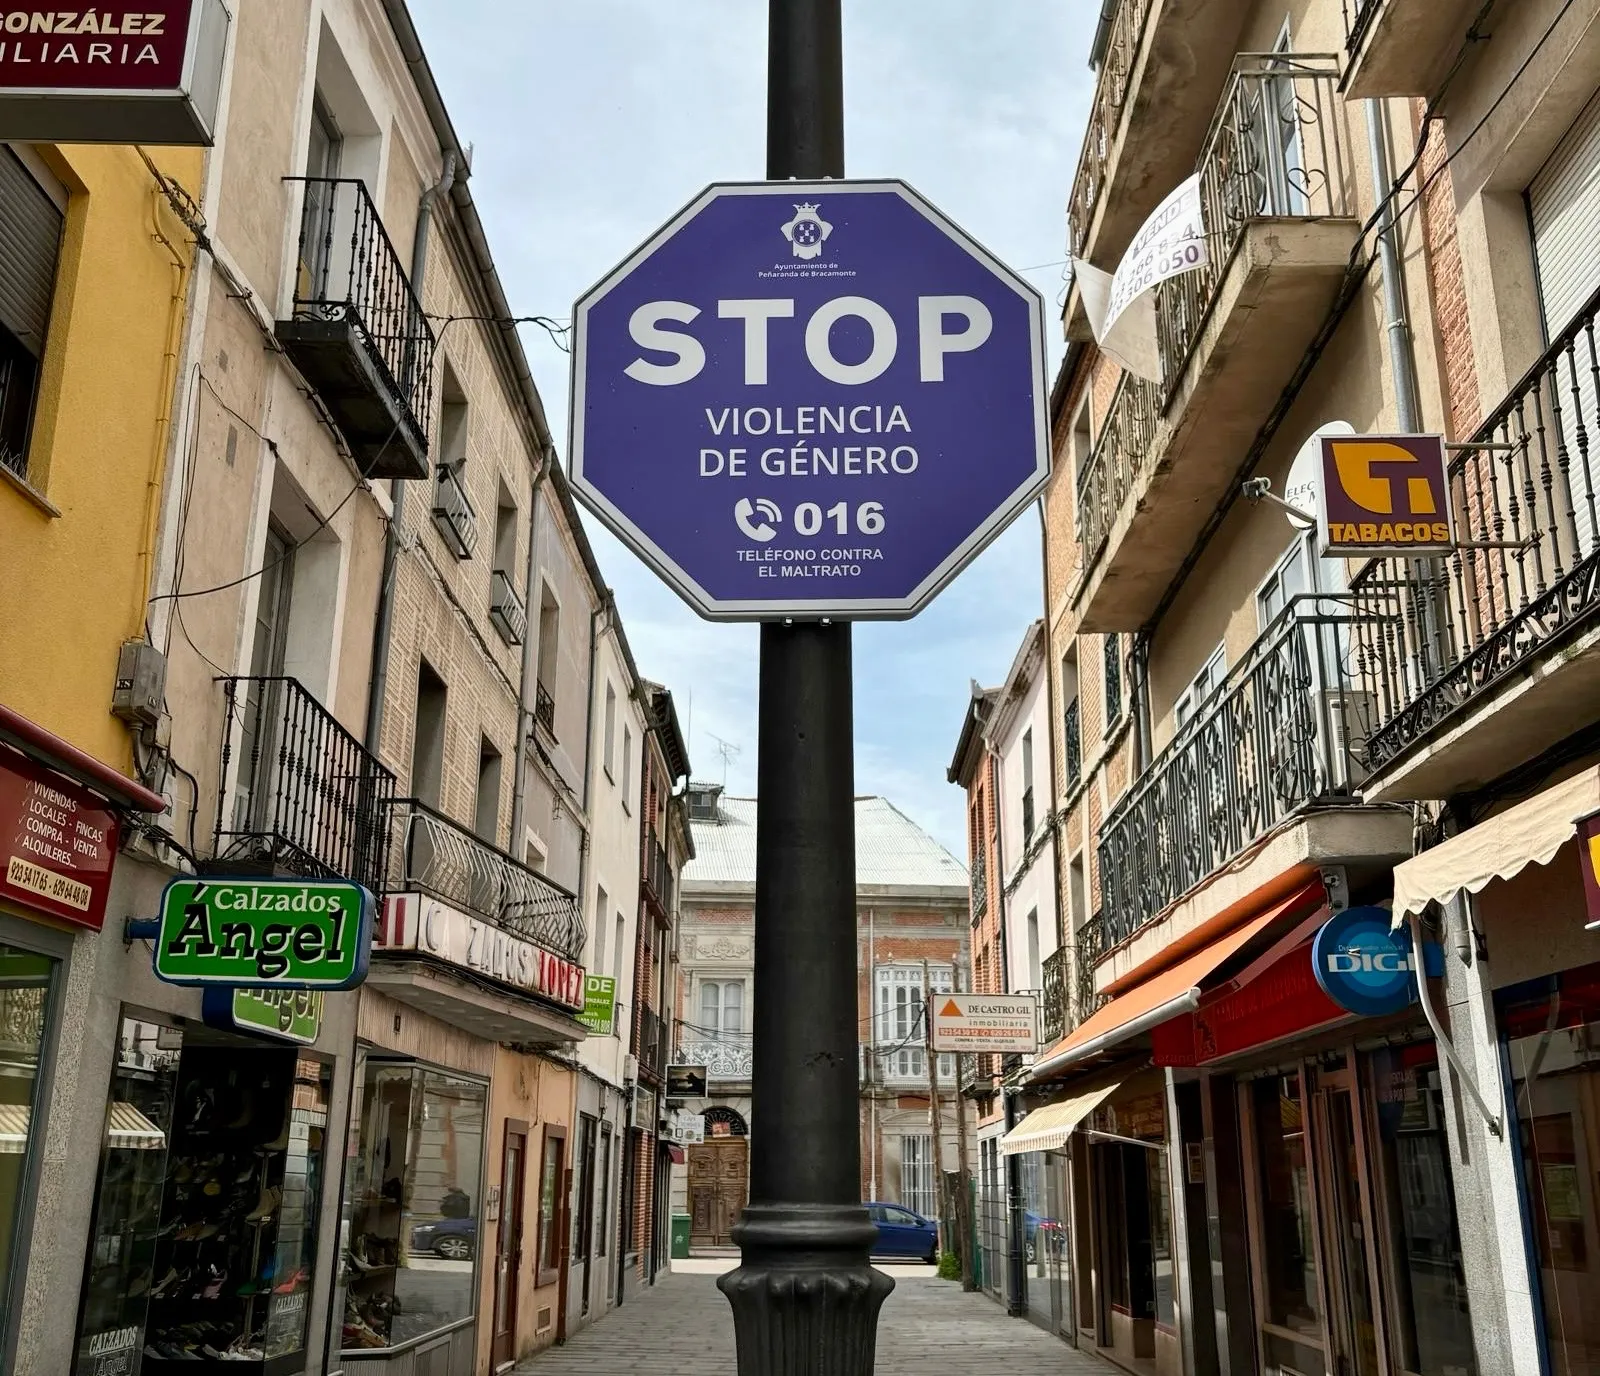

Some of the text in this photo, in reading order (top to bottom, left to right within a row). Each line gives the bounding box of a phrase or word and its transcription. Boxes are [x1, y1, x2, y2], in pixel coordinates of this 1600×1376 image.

[0, 8, 166, 35] ONZÁLEZ
[774, 263, 827, 271] Ayuntamiento
[1160, 245, 1199, 276] 050
[623, 295, 993, 386] STOP
[705, 404, 912, 436] VIOLENCIA
[700, 440, 919, 477] DE GÉNERO
[793, 501, 886, 536] 016
[1328, 522, 1449, 542] TABACOS
[736, 547, 884, 562] TELÉFONO CONTRA
[758, 565, 862, 577] EL MALTRATO
[34, 781, 77, 813] VIVIENDAS
[29, 798, 67, 827] LOCALES
[75, 820, 103, 843] FINCAS
[26, 817, 63, 844] COMPRA
[73, 837, 98, 859] VENTA
[10, 861, 23, 882] 923
[32, 869, 40, 887] 17
[214, 888, 341, 912] Calzados
[168, 882, 347, 979] Ángel
[1327, 952, 1416, 973] DIGI
[587, 978, 612, 993] DE
[968, 1005, 1031, 1014] DE CASTRO GIL
[89, 1326, 138, 1357] CALZADOS
